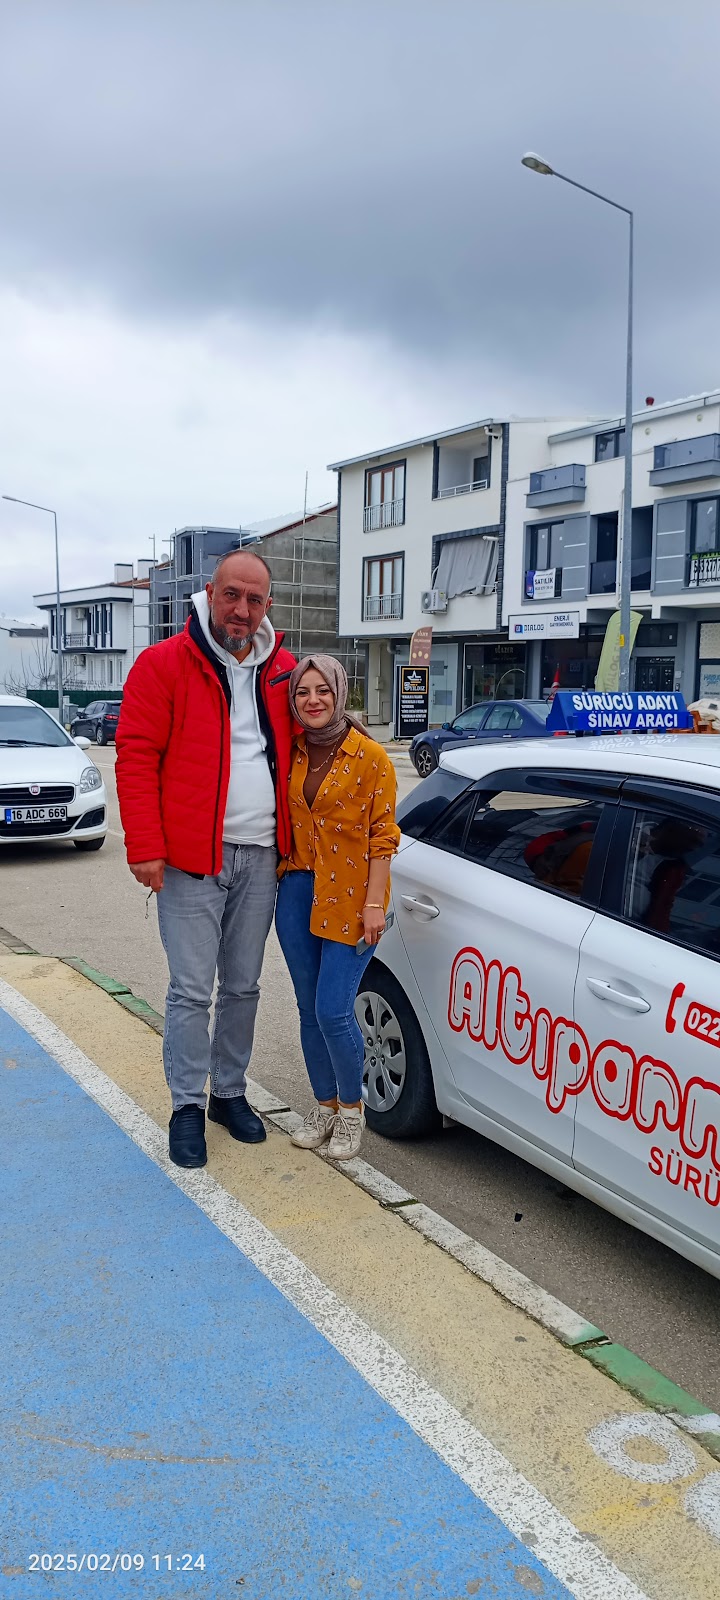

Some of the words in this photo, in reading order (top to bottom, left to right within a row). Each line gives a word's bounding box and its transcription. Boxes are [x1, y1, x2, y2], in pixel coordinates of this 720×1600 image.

[572, 692, 634, 711] SÜRÜCÜ
[637, 695, 679, 710] ADAYI
[588, 713, 632, 728] SINAV
[635, 713, 678, 728] ARACI
[12, 810, 23, 820] 16
[26, 808, 45, 820] ADC
[48, 807, 66, 818] 669
[688, 1007, 720, 1041] 022
[648, 1146, 720, 1207] SÜRÜ
